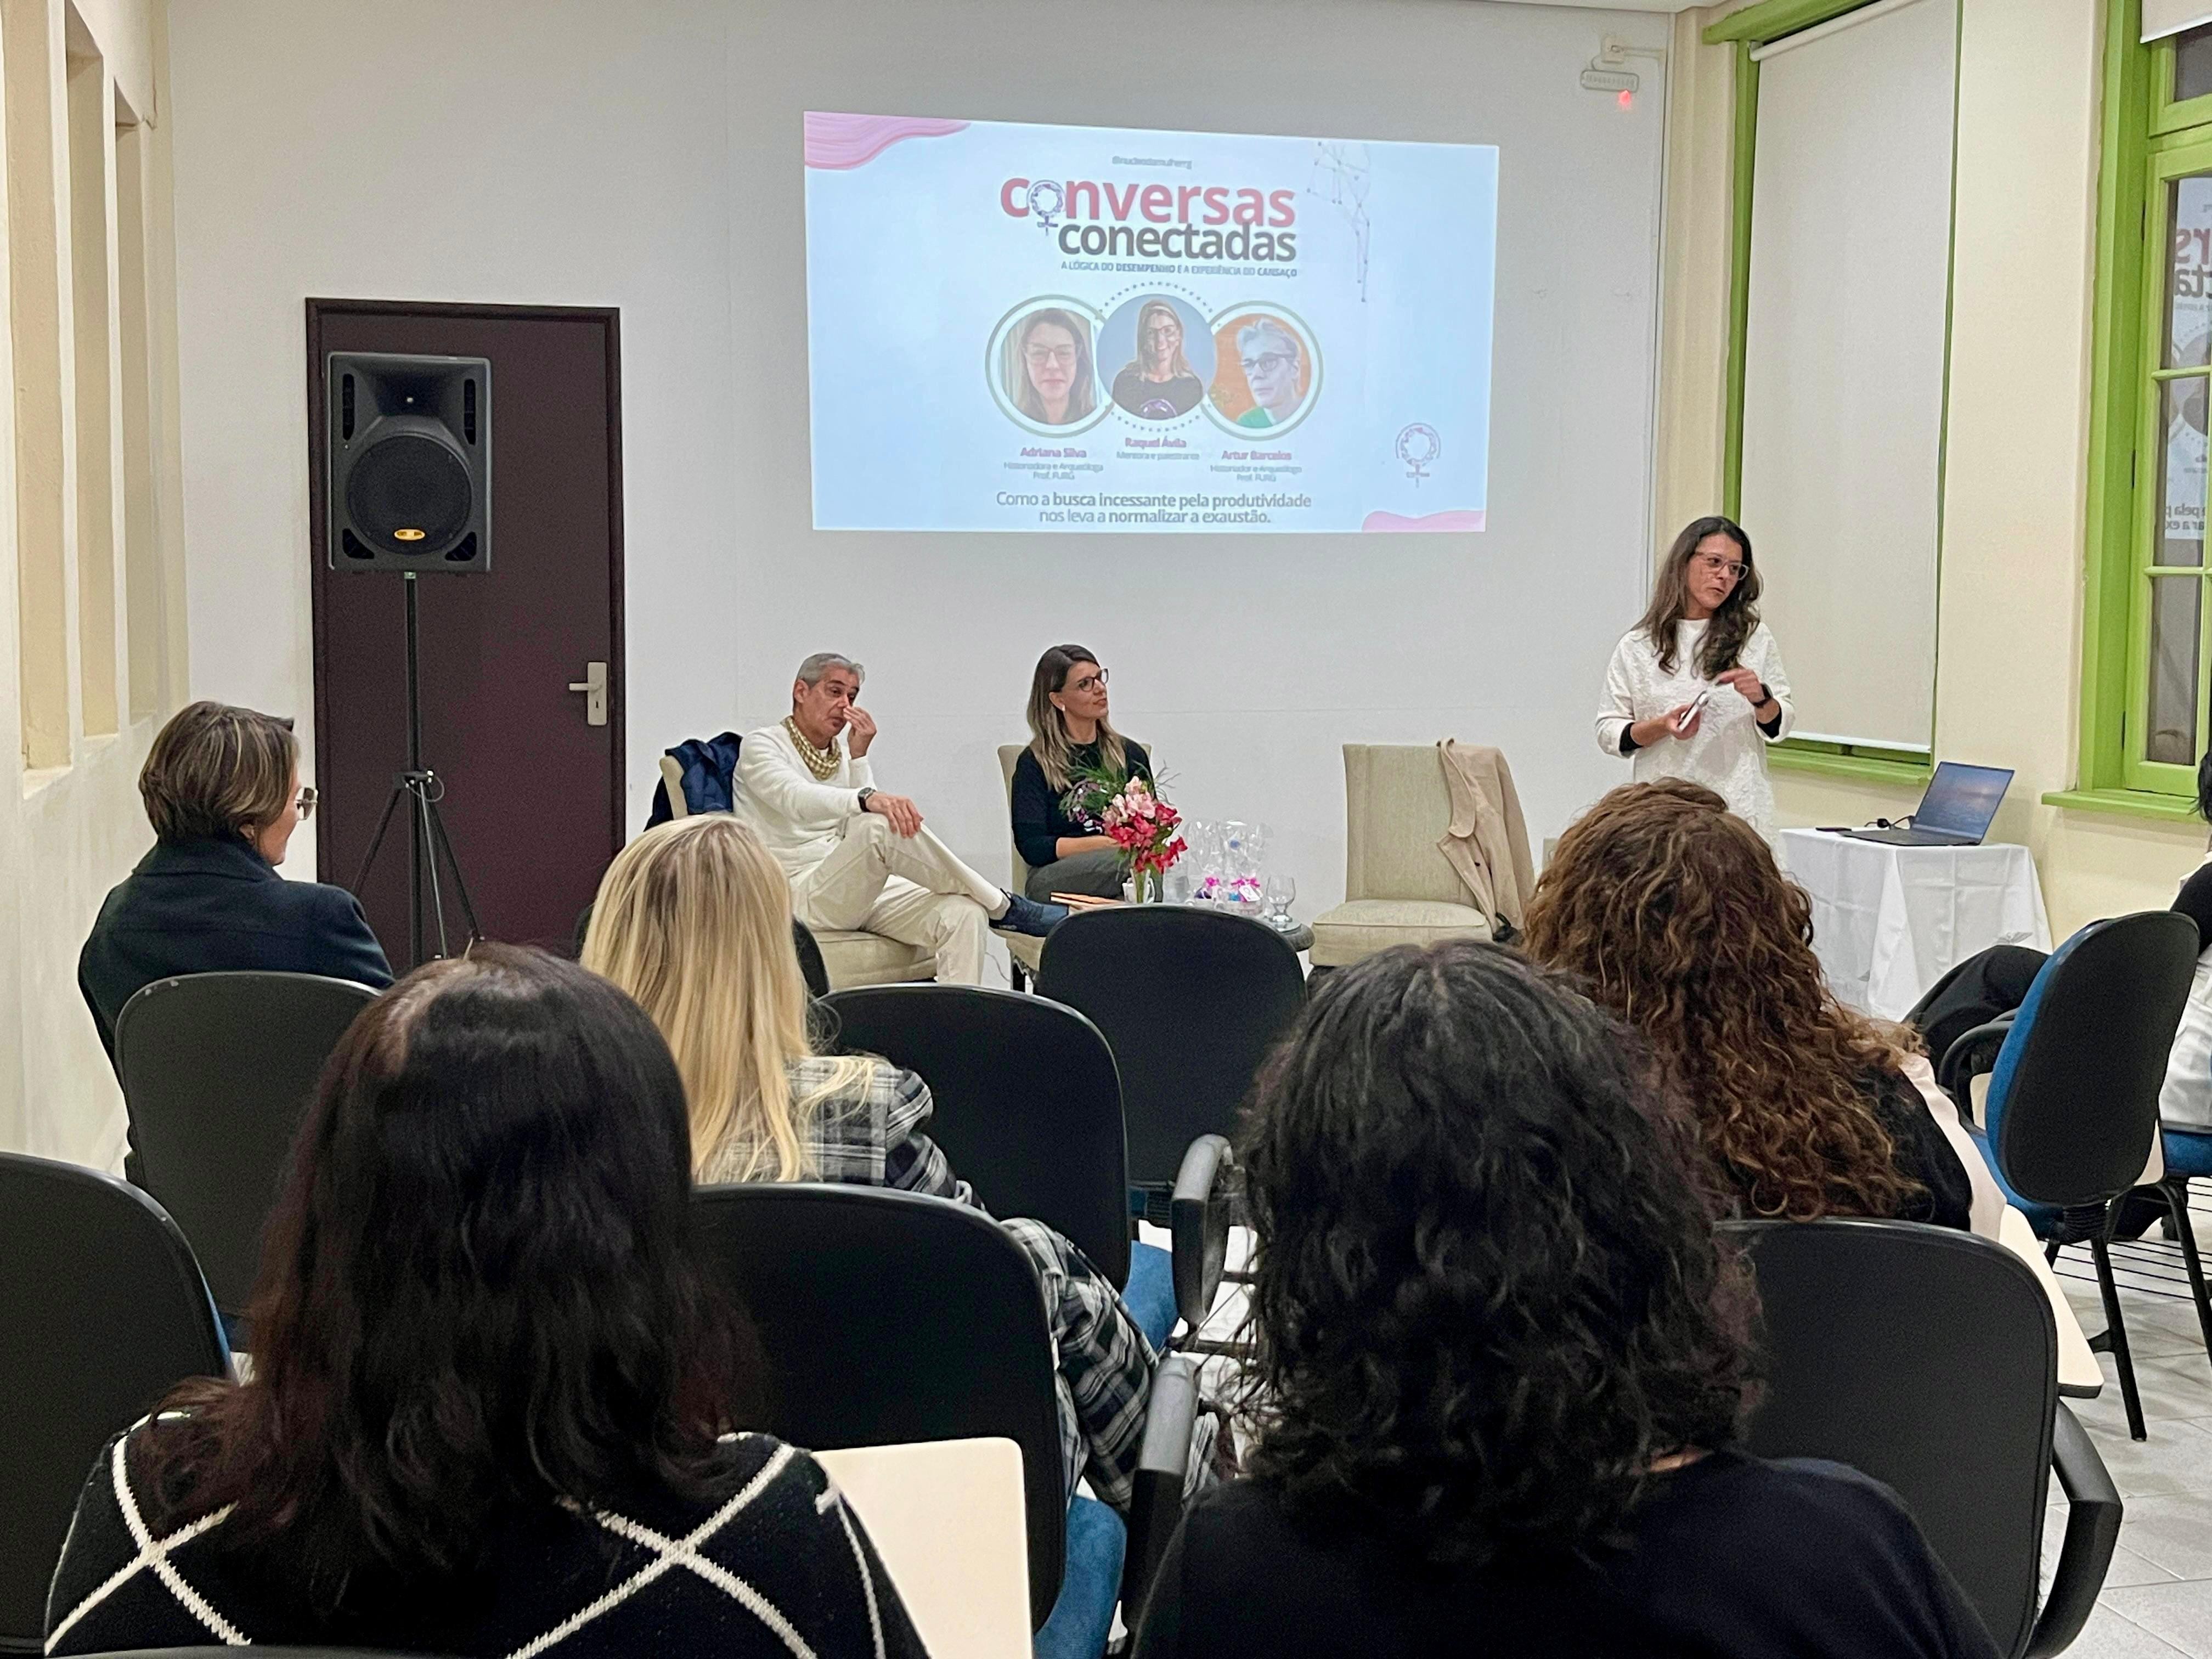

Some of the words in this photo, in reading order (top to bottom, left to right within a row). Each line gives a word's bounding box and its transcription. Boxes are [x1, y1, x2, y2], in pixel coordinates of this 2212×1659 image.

[1000, 177, 1296, 227] conversas
[1058, 221, 1296, 262] conectadas
[1069, 261, 1099, 270] LÓGICA
[1102, 262, 1114, 272] DO
[1116, 263, 1175, 273] DESEMPENHO
[1183, 266, 1189, 274] A
[1192, 265, 1241, 275] EXPERIÊNCIA
[1243, 267, 1255, 275] DO
[1257, 268, 1297, 279] CANSAÇO
[1125, 437, 1160, 449] Raquel
[1161, 435, 1187, 448] Ávila
[1020, 447, 1061, 457] Adriana
[1064, 448, 1087, 458] Silva
[1222, 450, 1249, 460] Artur
[996, 492, 1039, 505] Como
[1042, 495, 1050, 505] a
[1053, 492, 1095, 506] busca
[1099, 493, 1176, 507] incessante
[1180, 493, 1209, 511] pela
[1212, 493, 1311, 511] produtividade
[1040, 511, 1064, 522] nos
[1068, 509, 1094, 522] leva
[1097, 511, 1105, 522] a
[1109, 509, 1188, 523] normalizar
[1190, 512, 1199, 523] a
[1202, 510, 1271, 523] exaustão.
